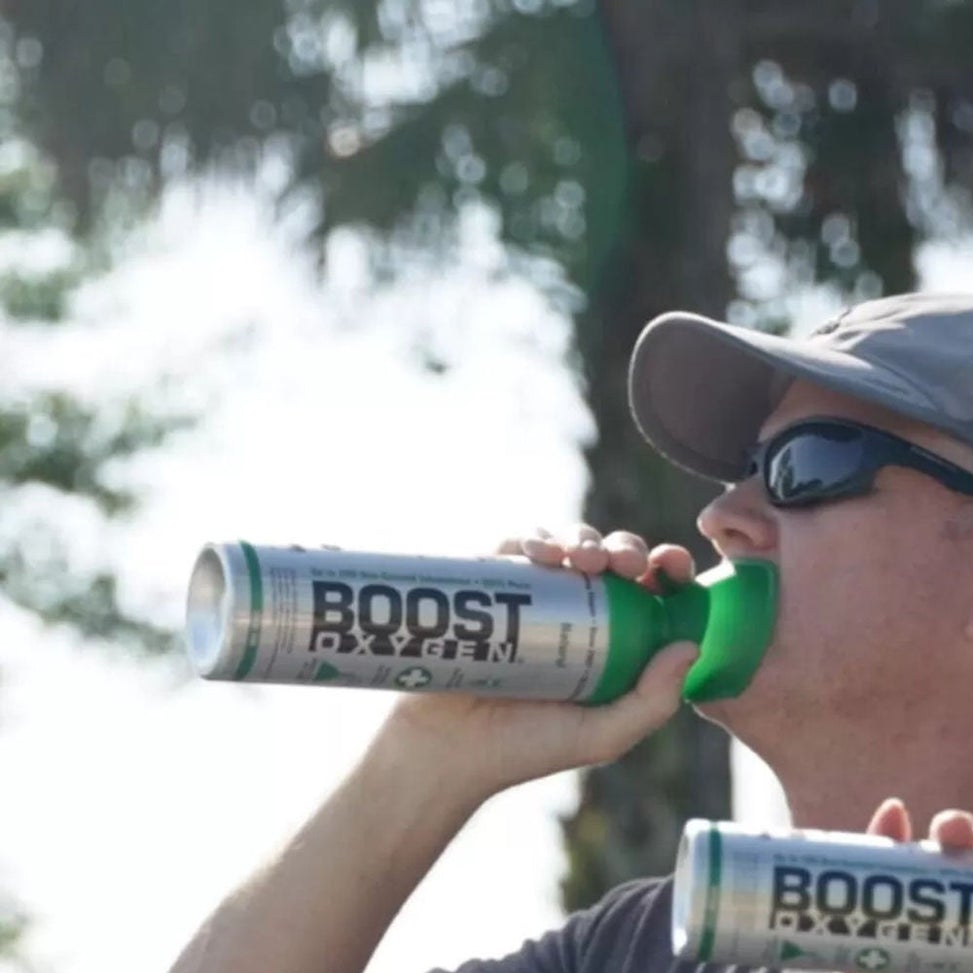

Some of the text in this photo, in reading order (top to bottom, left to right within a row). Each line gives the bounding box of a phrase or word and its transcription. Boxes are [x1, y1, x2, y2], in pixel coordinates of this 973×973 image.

[311, 580, 533, 646] BOOST
[312, 631, 518, 664] OXYGEN
[770, 911, 973, 947] OXYGEN
